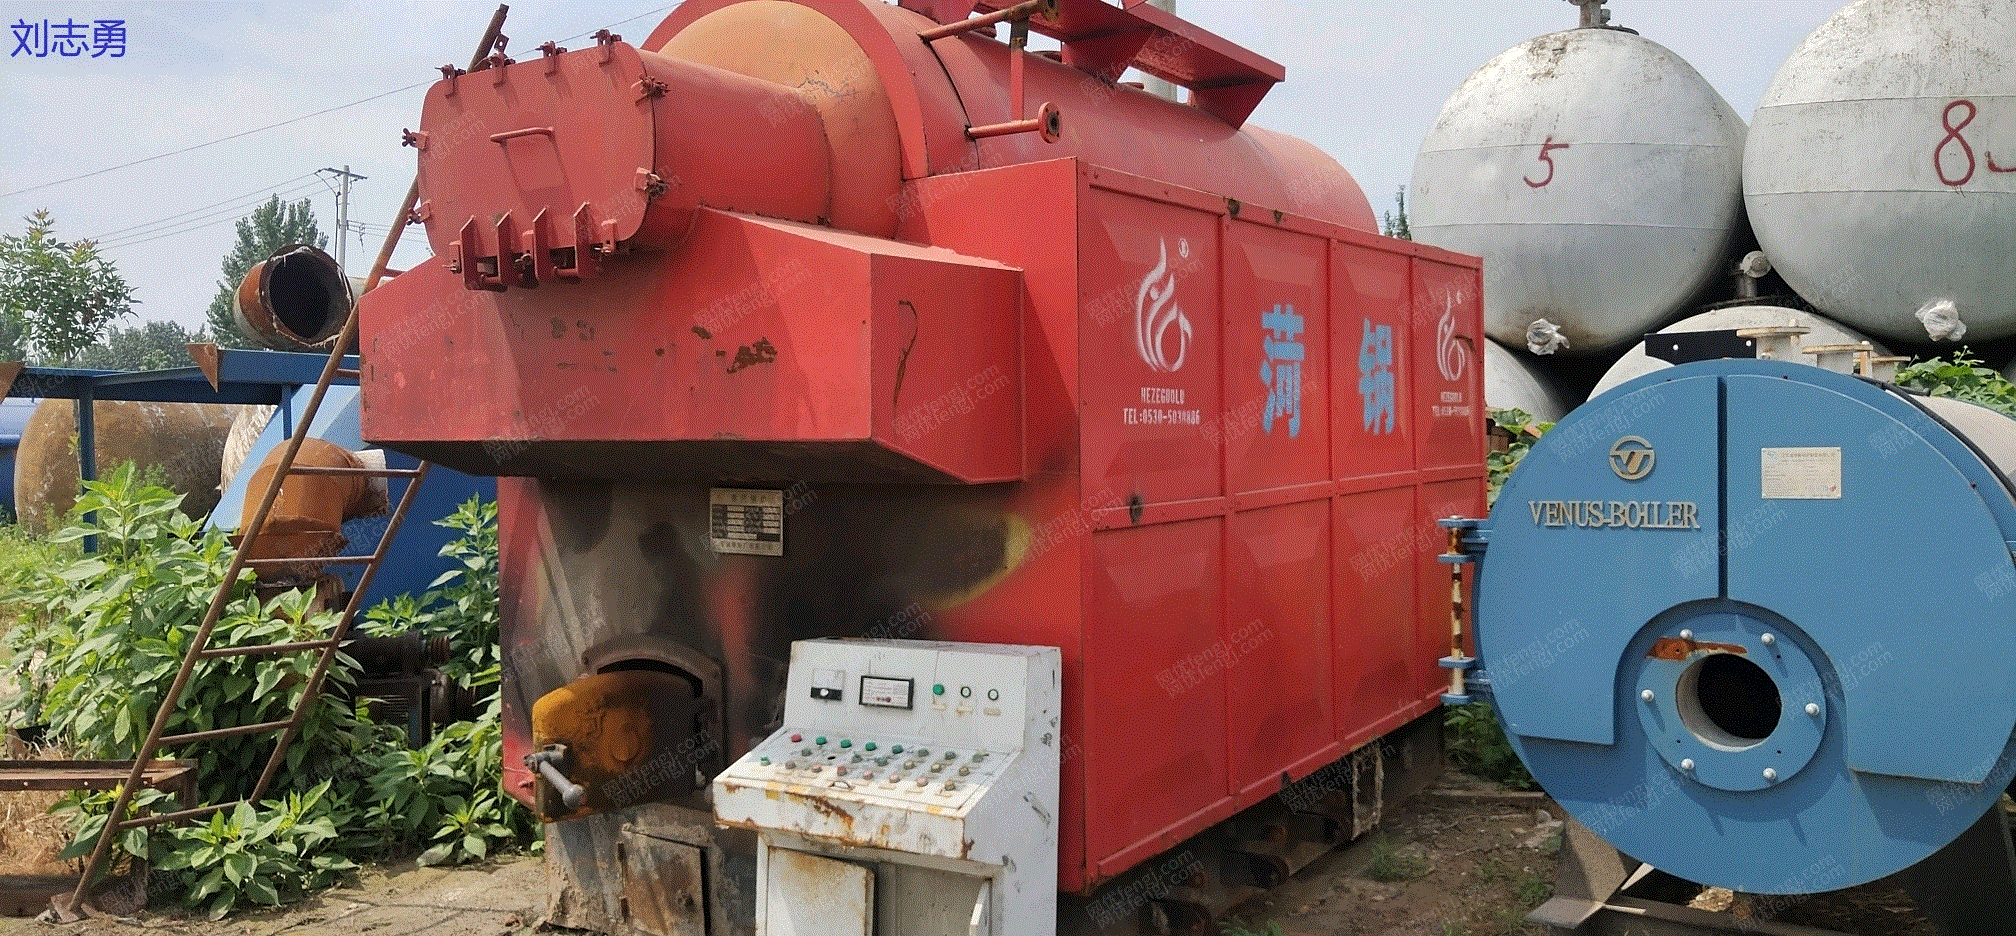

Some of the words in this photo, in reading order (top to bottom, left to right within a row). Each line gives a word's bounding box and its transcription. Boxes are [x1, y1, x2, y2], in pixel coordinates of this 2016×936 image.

[1523, 135, 1569, 188] 5
[1260, 304, 1305, 438] 菏
[1359, 317, 1395, 435] 锅
[1528, 500, 1701, 530] VENUS-BOILER
